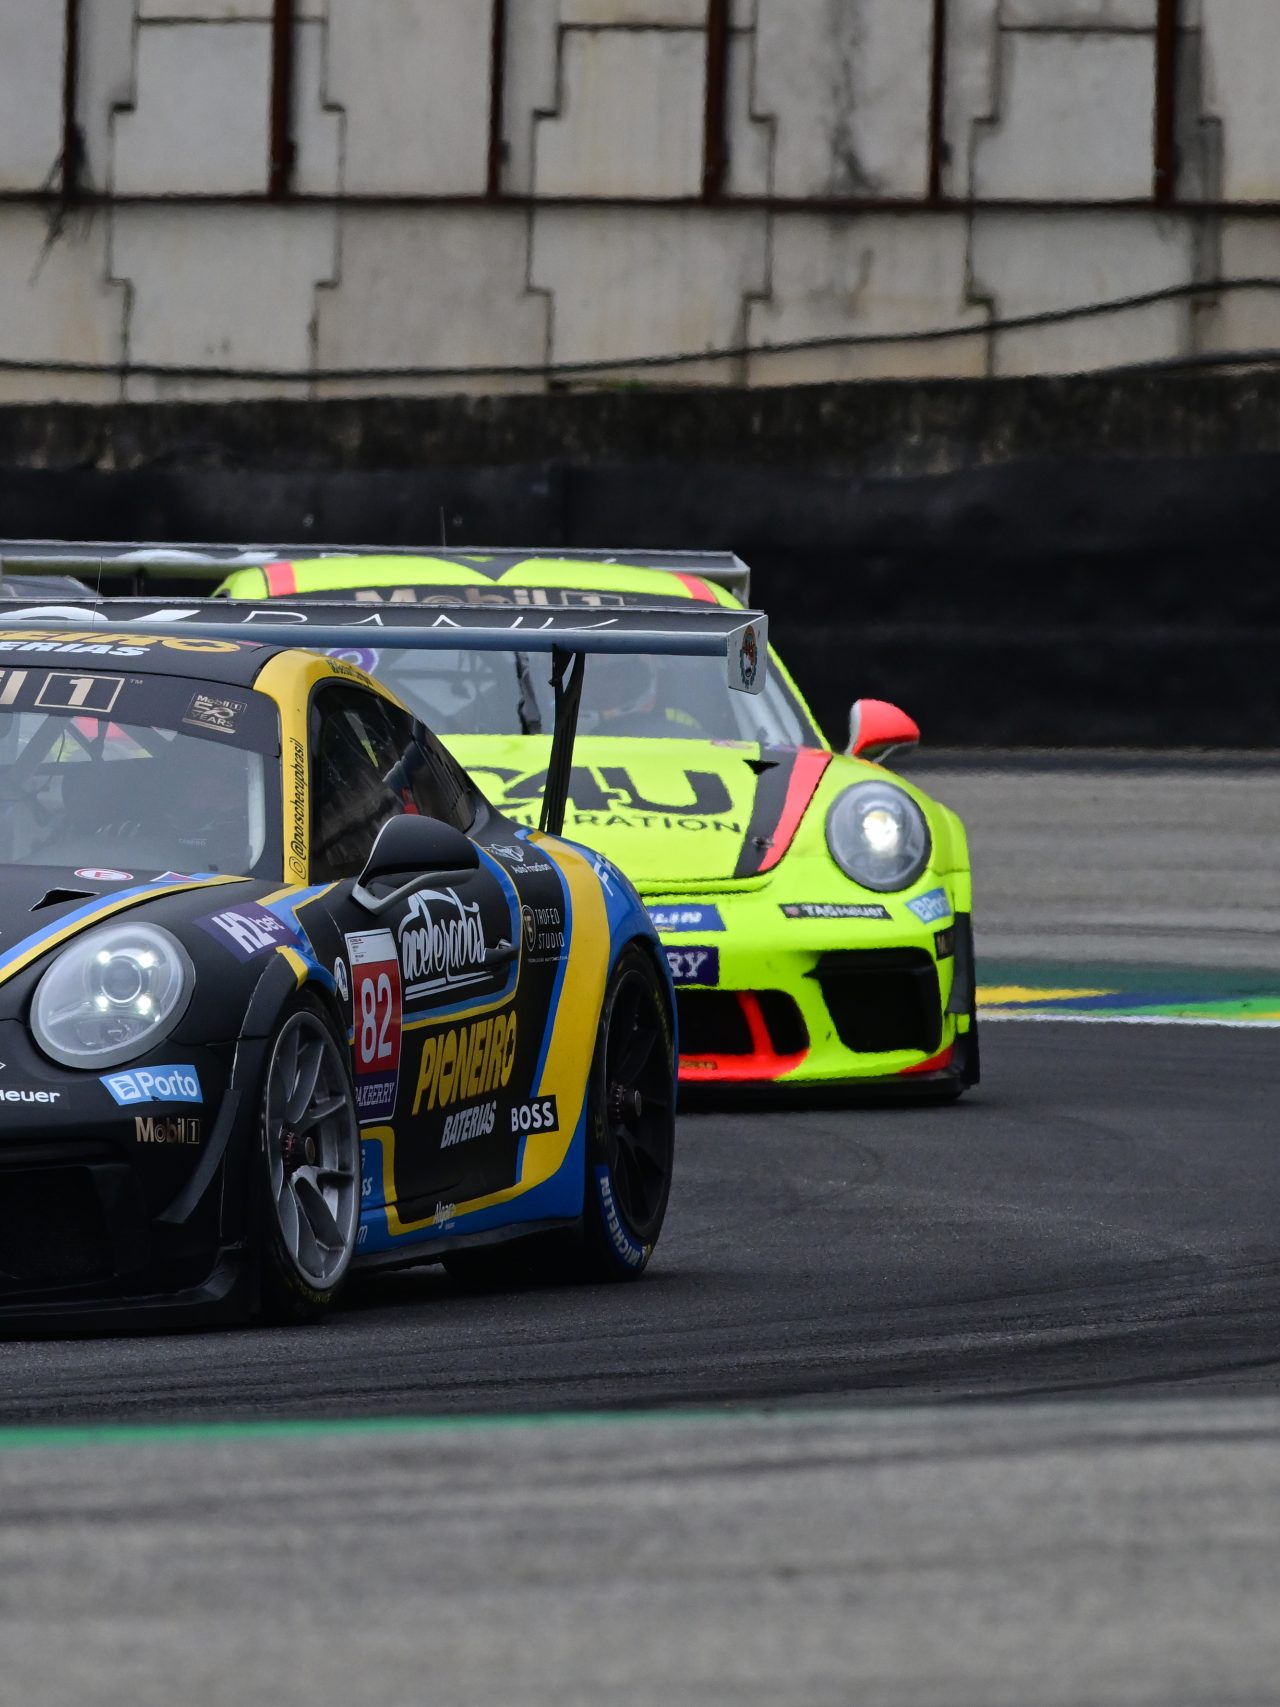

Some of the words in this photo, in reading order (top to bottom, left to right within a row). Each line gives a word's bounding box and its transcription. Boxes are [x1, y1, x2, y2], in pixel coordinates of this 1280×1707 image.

[191, 711, 234, 728] YEARS
[289, 737, 309, 861] @porschecupbrasil
[535, 907, 561, 926] TROFEO
[538, 931, 565, 950] STUDIO
[360, 972, 393, 1064] 82
[411, 1009, 518, 1117] PIONEIRO
[135, 1070, 198, 1098] Porto
[355, 1081, 396, 1107] AKBERRY
[135, 1116, 185, 1144] Mobil
[440, 1100, 497, 1149] BATERIAS
[511, 1101, 554, 1132] BOSS
